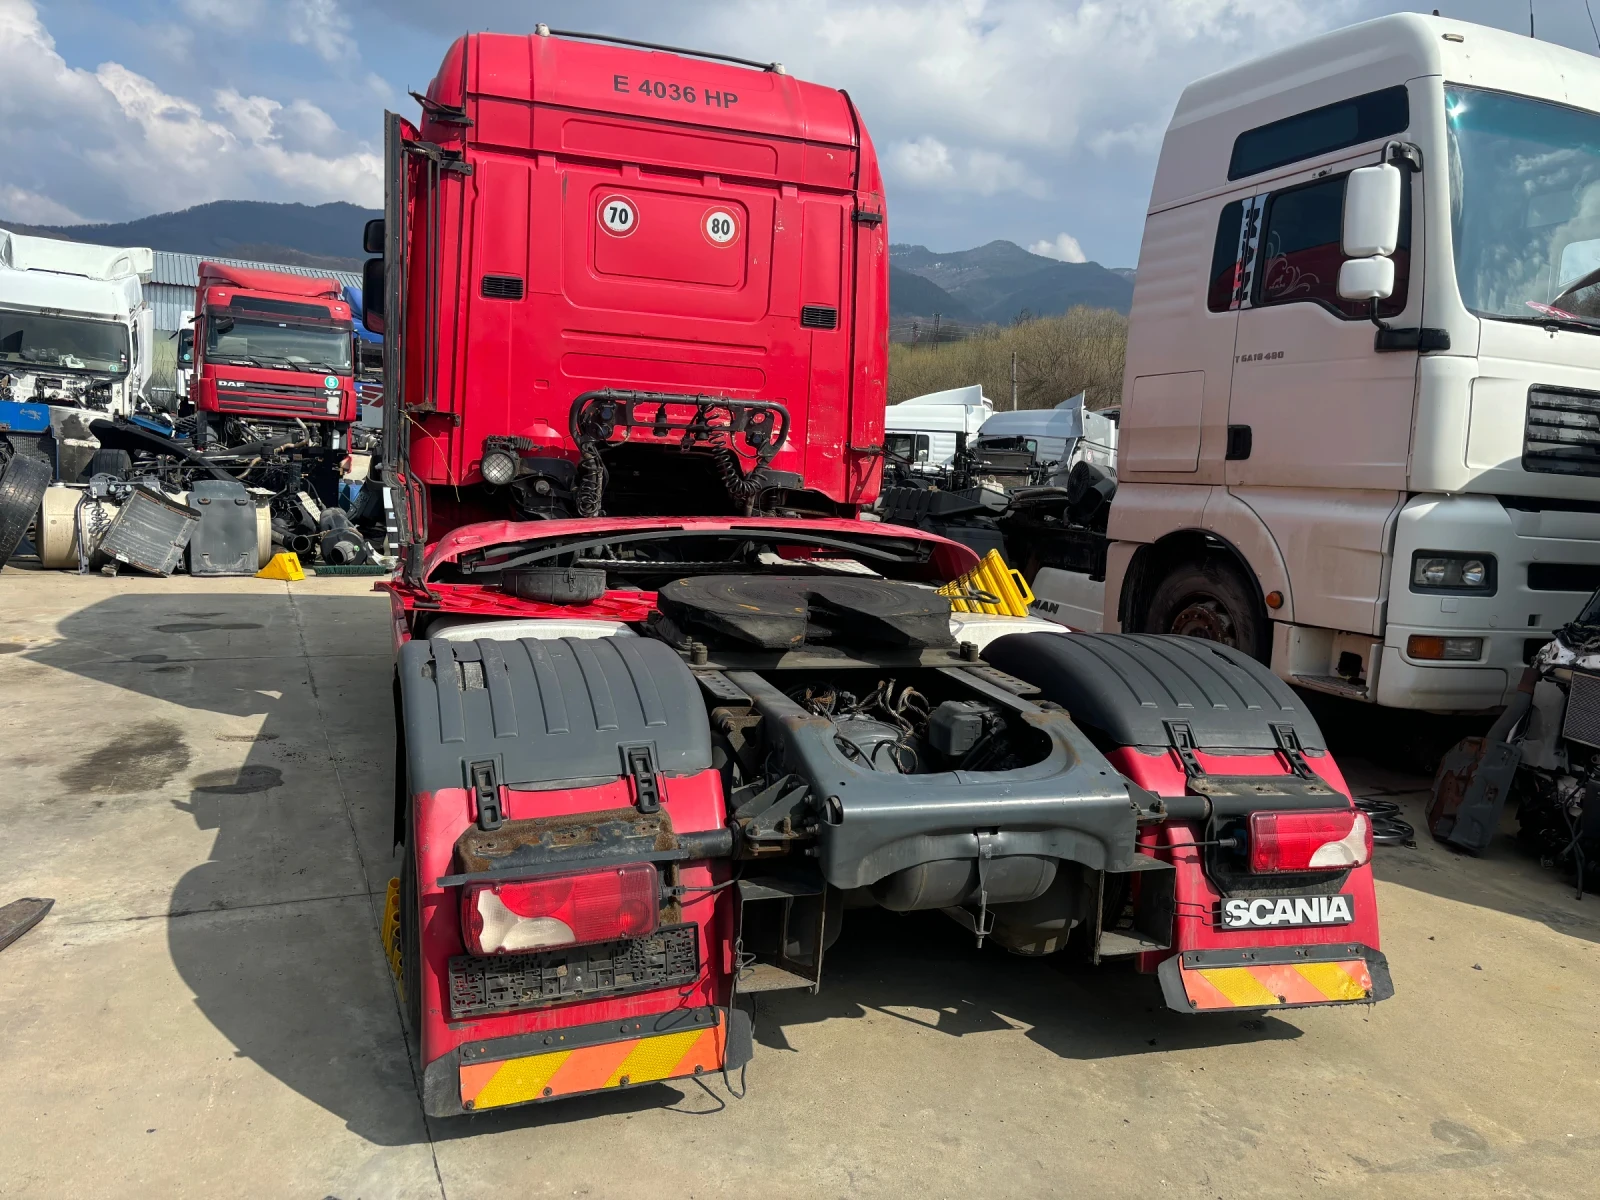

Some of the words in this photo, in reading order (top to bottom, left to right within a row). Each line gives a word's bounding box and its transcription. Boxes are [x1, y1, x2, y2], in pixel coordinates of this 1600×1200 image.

[613, 74, 630, 93] E
[638, 79, 697, 104] 4036
[704, 88, 739, 109] HP
[609, 206, 629, 225] 70
[711, 217, 730, 236] 80
[217, 380, 246, 388] DAF
[1224, 896, 1353, 927] SCANIA
